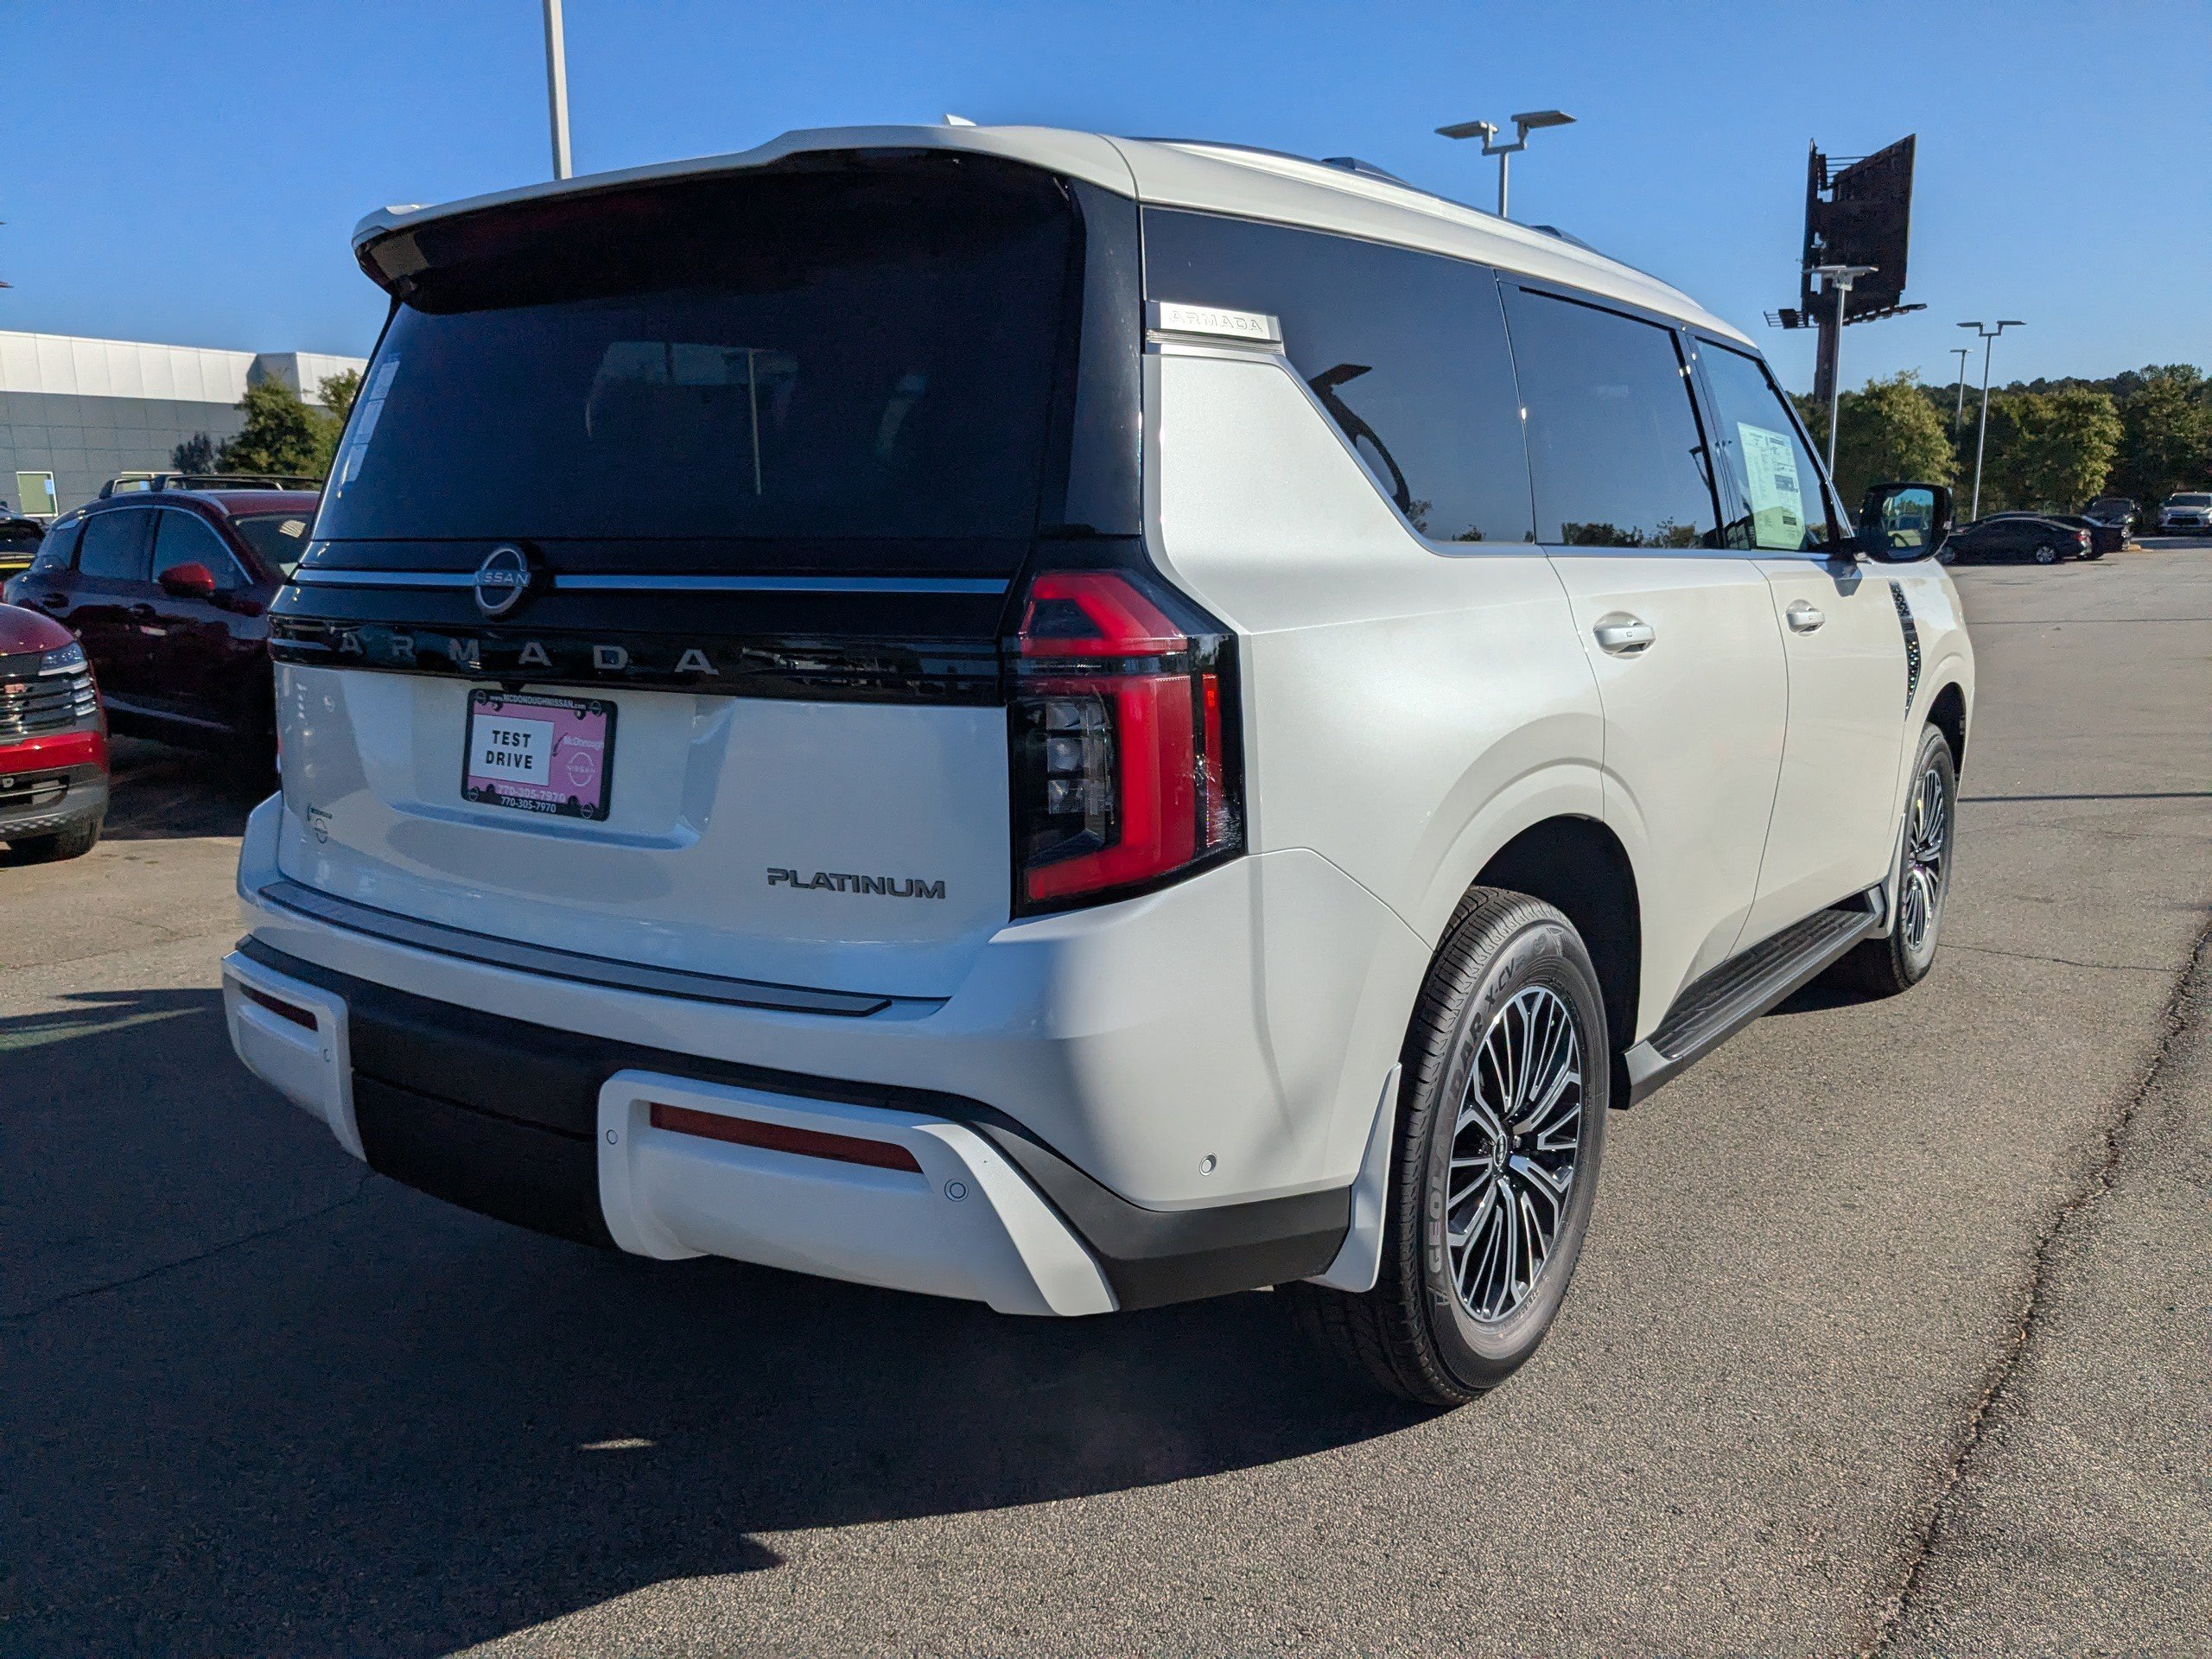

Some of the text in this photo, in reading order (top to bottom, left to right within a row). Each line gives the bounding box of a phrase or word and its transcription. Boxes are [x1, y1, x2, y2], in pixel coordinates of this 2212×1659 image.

[1170, 310, 1263, 333] ARMADA
[474, 571, 529, 585] SSAN
[339, 631, 719, 676] ARMADA
[493, 730, 531, 748] TEST
[486, 750, 533, 769] DRIVE
[501, 795, 557, 813] 770-305-7970
[766, 868, 946, 899] PLATINUM
